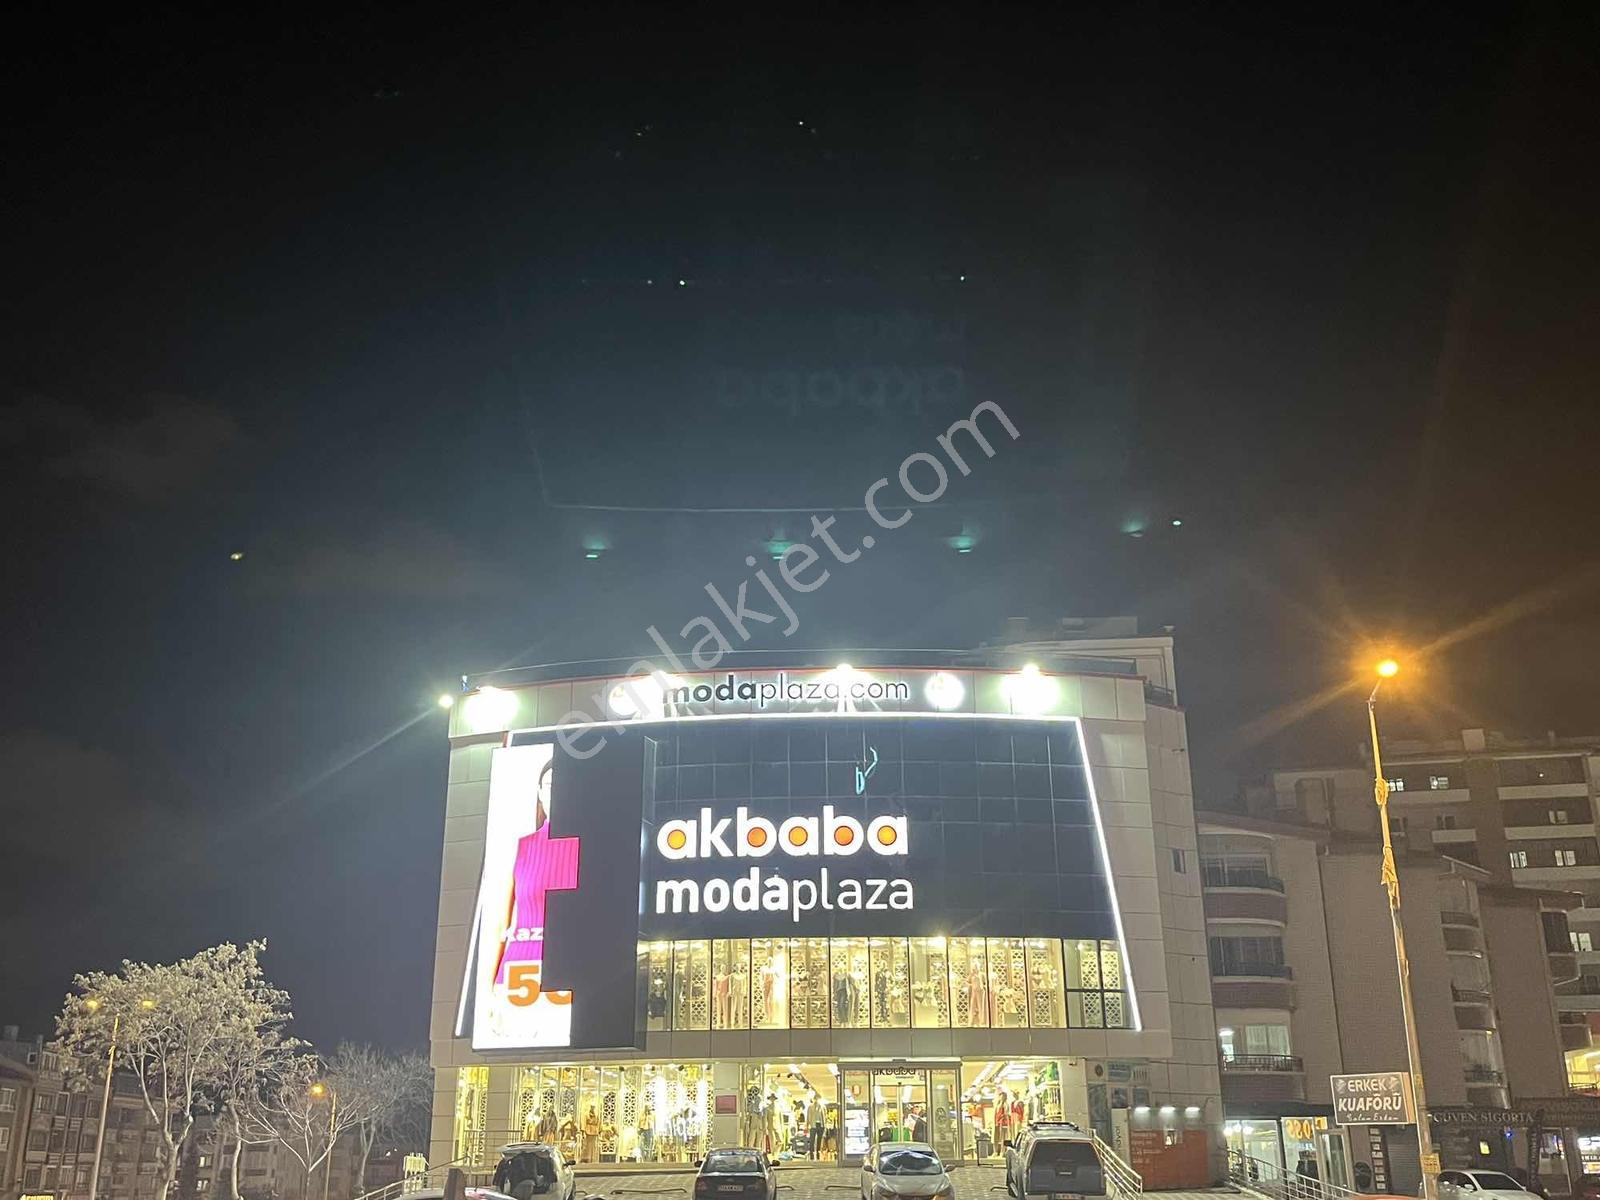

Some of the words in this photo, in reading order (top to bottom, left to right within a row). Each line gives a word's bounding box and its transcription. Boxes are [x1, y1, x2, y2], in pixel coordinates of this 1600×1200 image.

[663, 672, 908, 707] modaplaza.com
[656, 805, 909, 859] akbaba
[655, 867, 915, 921] modaplaza
[507, 964, 571, 1007] 5
[1338, 1092, 1402, 1112] KUAFÖRÜ
[1347, 1078, 1388, 1093] ERKEK
